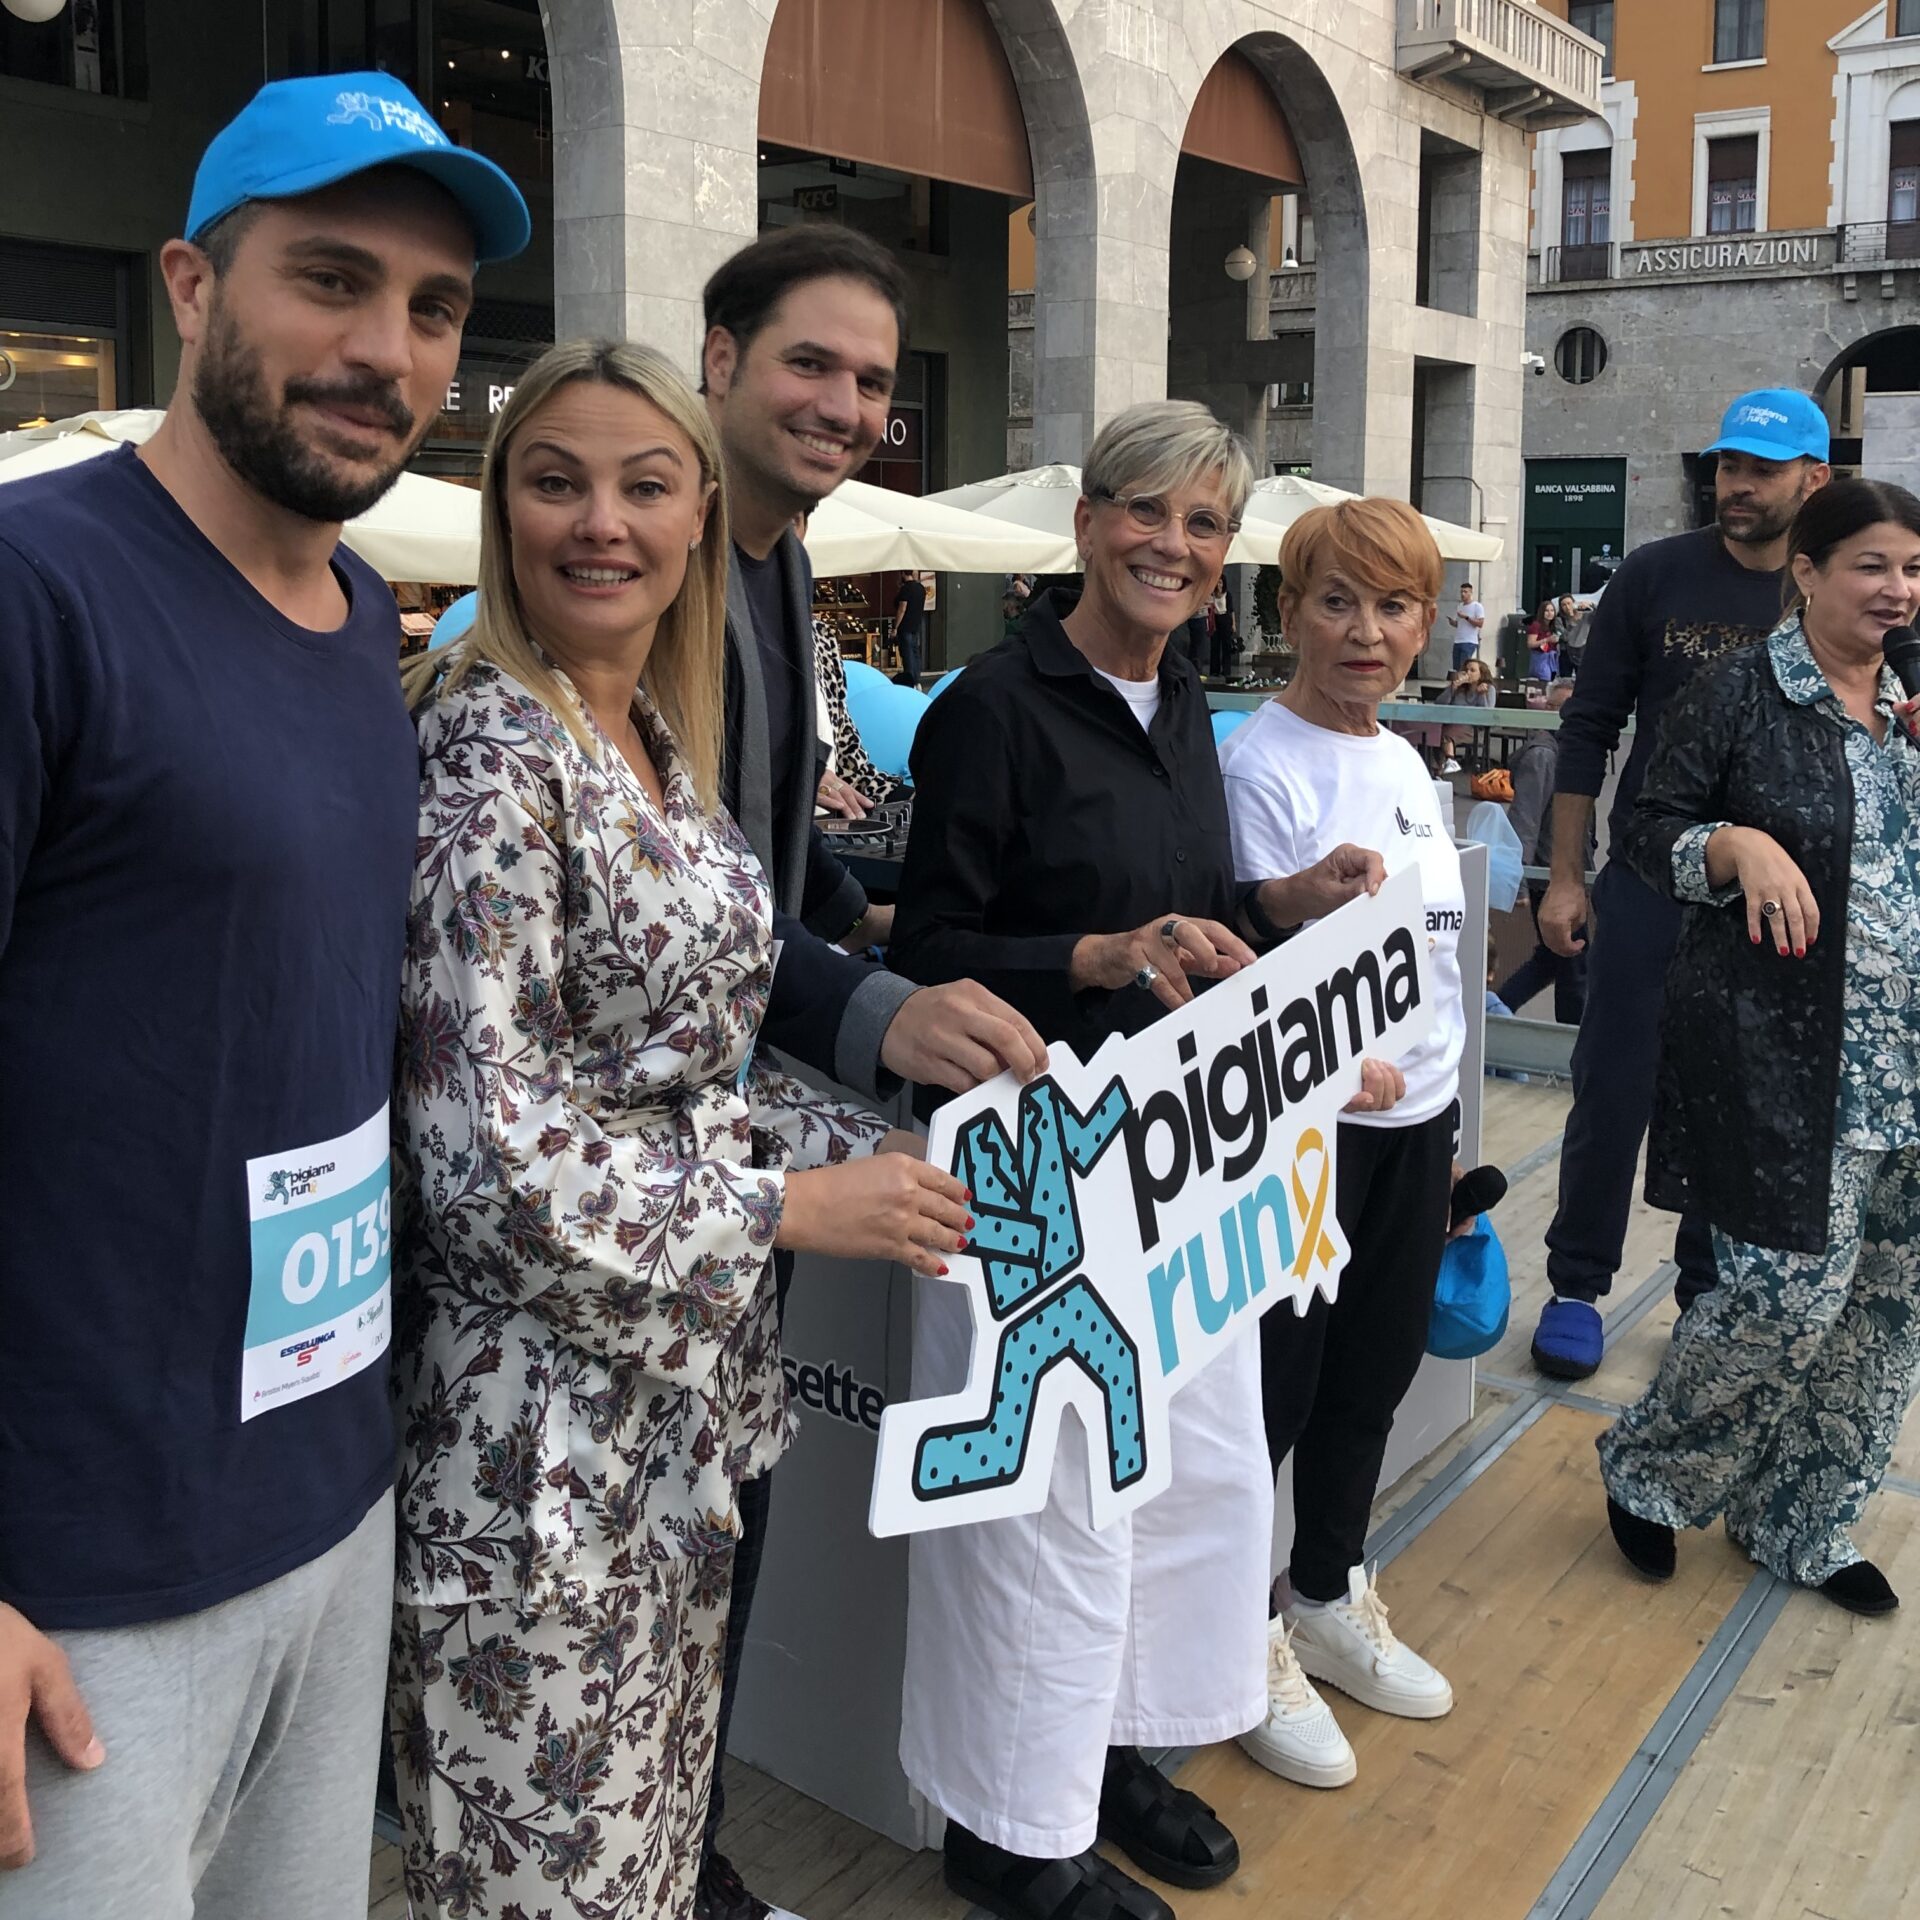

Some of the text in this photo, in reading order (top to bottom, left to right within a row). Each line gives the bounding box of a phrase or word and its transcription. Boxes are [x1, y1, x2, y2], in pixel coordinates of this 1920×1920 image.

[798, 190, 834, 208] KFC
[1637, 238, 1818, 273] ASSICURAZIONI
[1749, 407, 1789, 424] pigiama
[1535, 484, 1616, 493] BANCA VALSABBINA
[1424, 905, 1463, 931] ama
[1123, 926, 1421, 1253] pigiama
[290, 1161, 336, 1185] pigiama
[290, 1183, 311, 1197] run
[1147, 1174, 1296, 1377] run
[280, 1330, 336, 1358] ESSELUNGA
